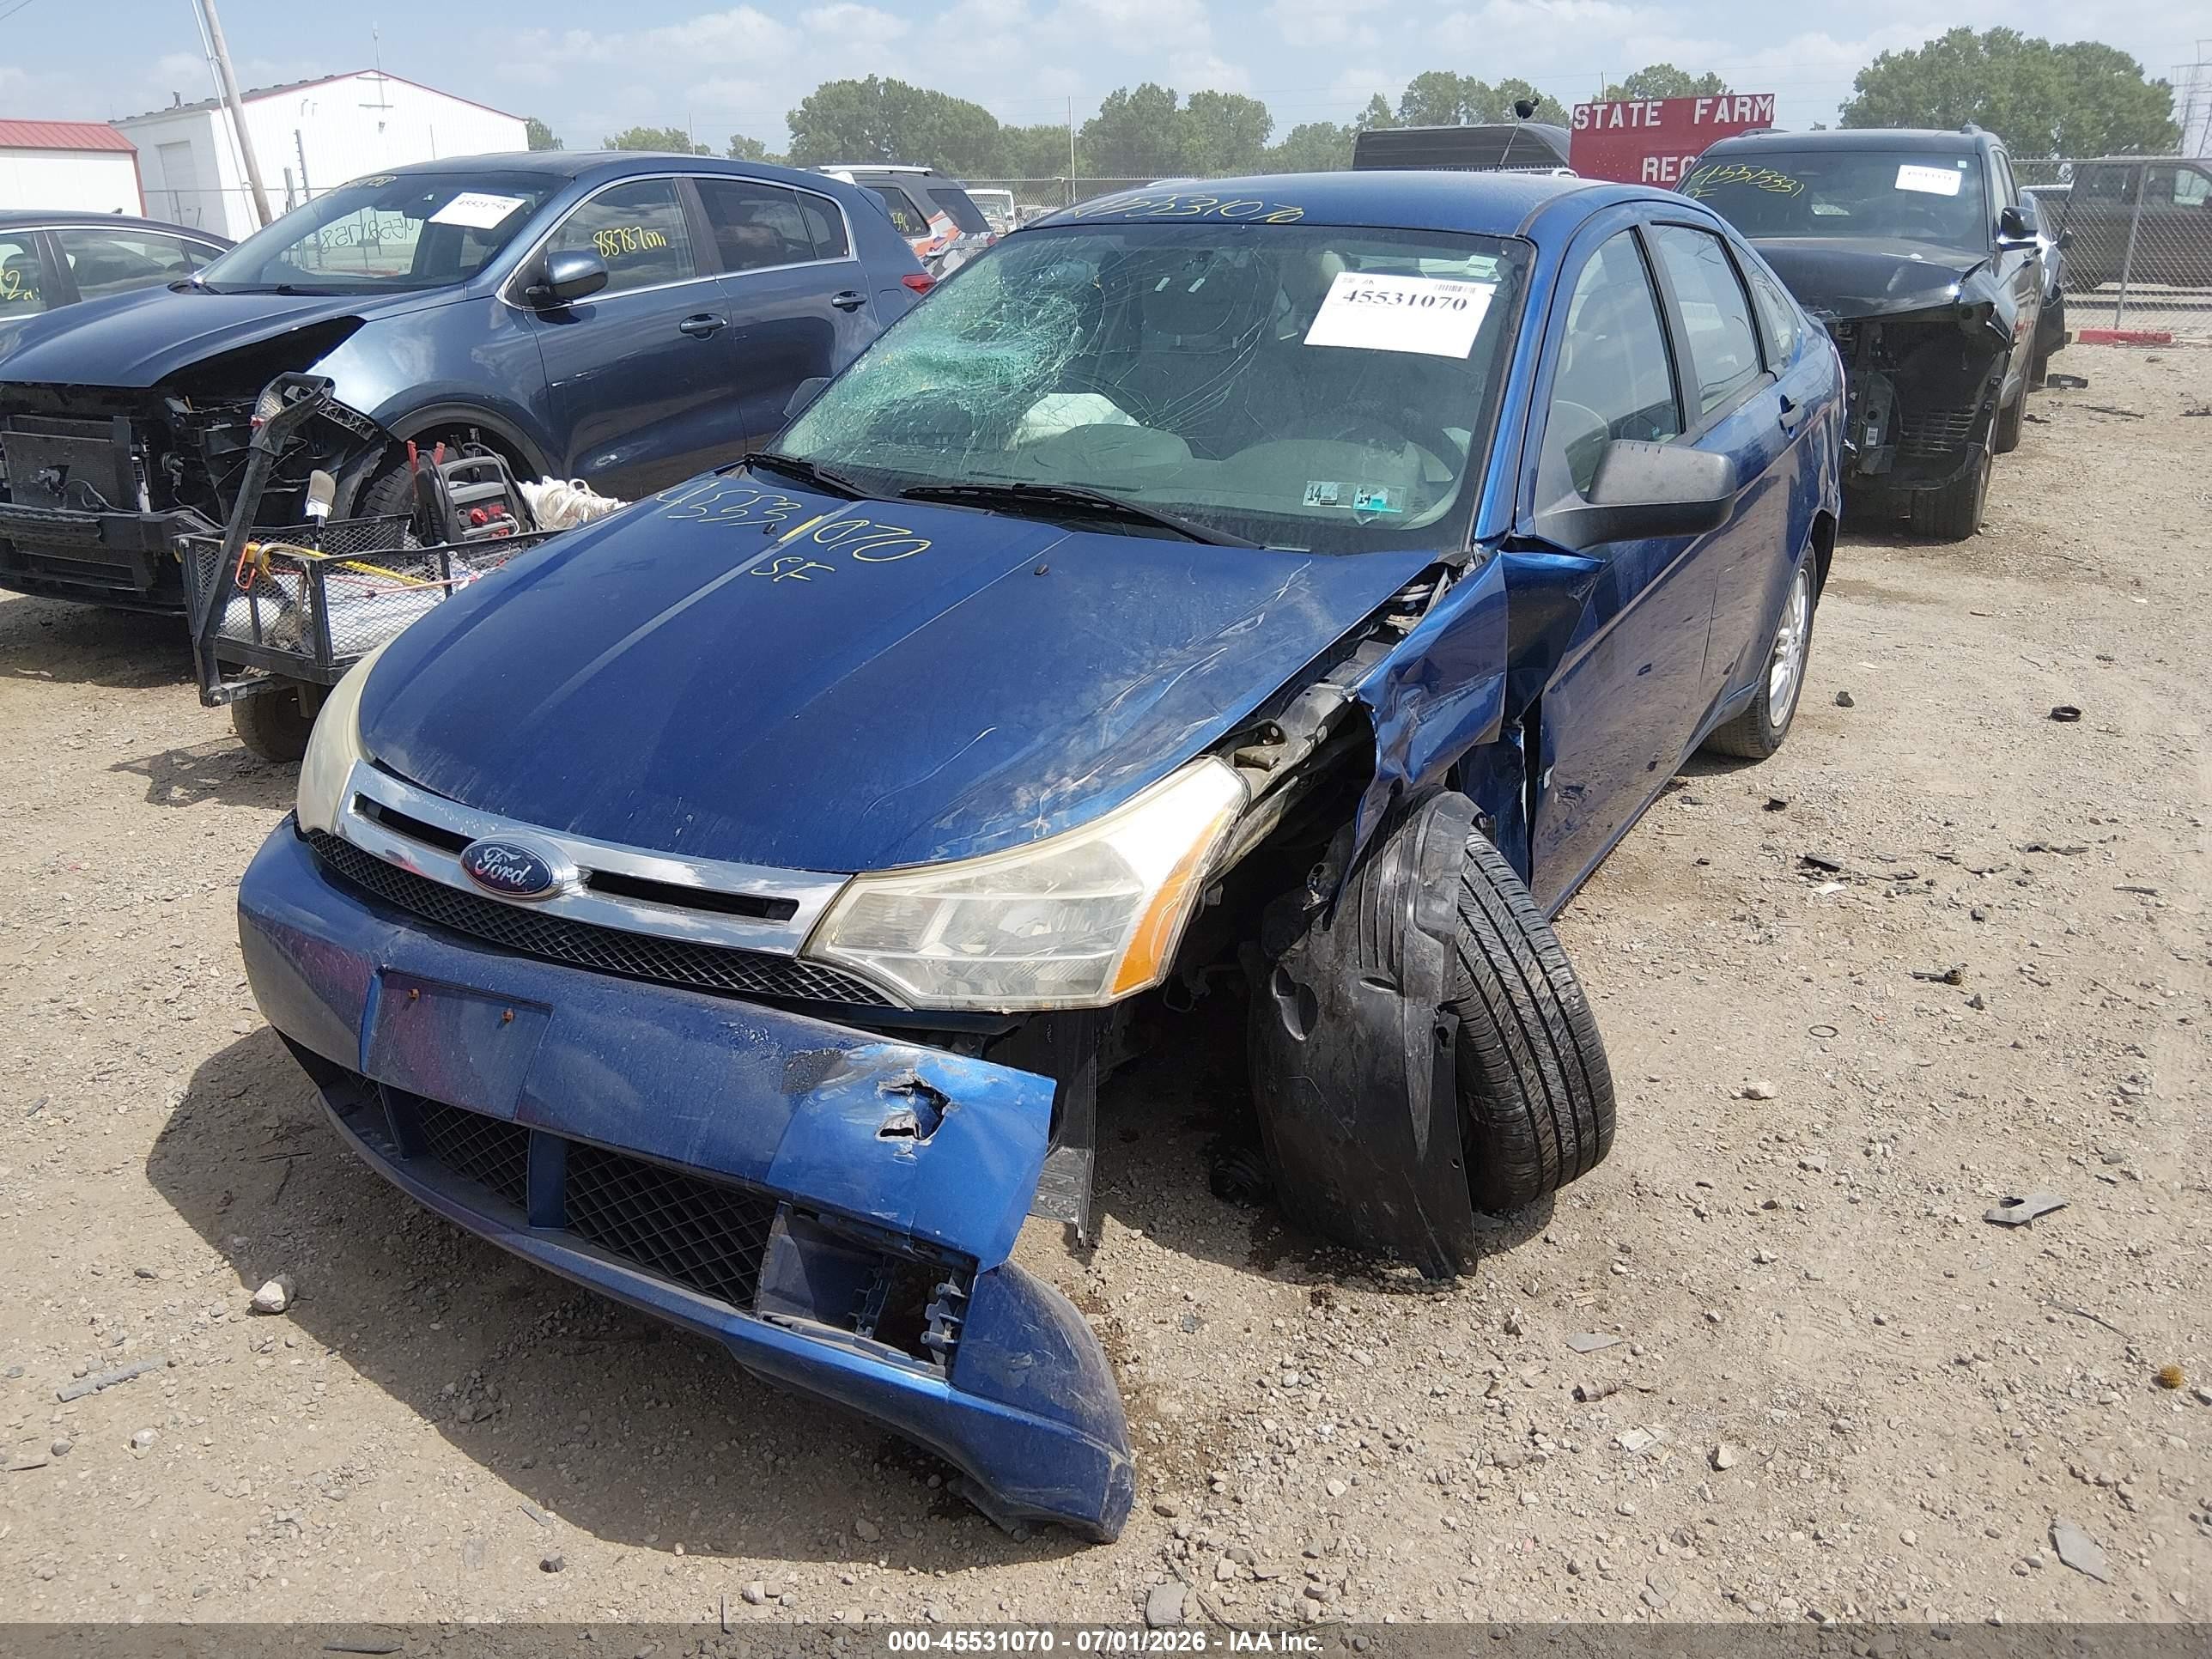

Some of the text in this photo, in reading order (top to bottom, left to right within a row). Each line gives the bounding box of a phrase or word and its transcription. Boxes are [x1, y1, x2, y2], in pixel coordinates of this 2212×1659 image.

[1573, 95, 1774, 130] STATE FARM
[1342, 289, 1468, 311] 45531070
[1307, 484, 1322, 502] 14
[474, 847, 533, 886] Ford
